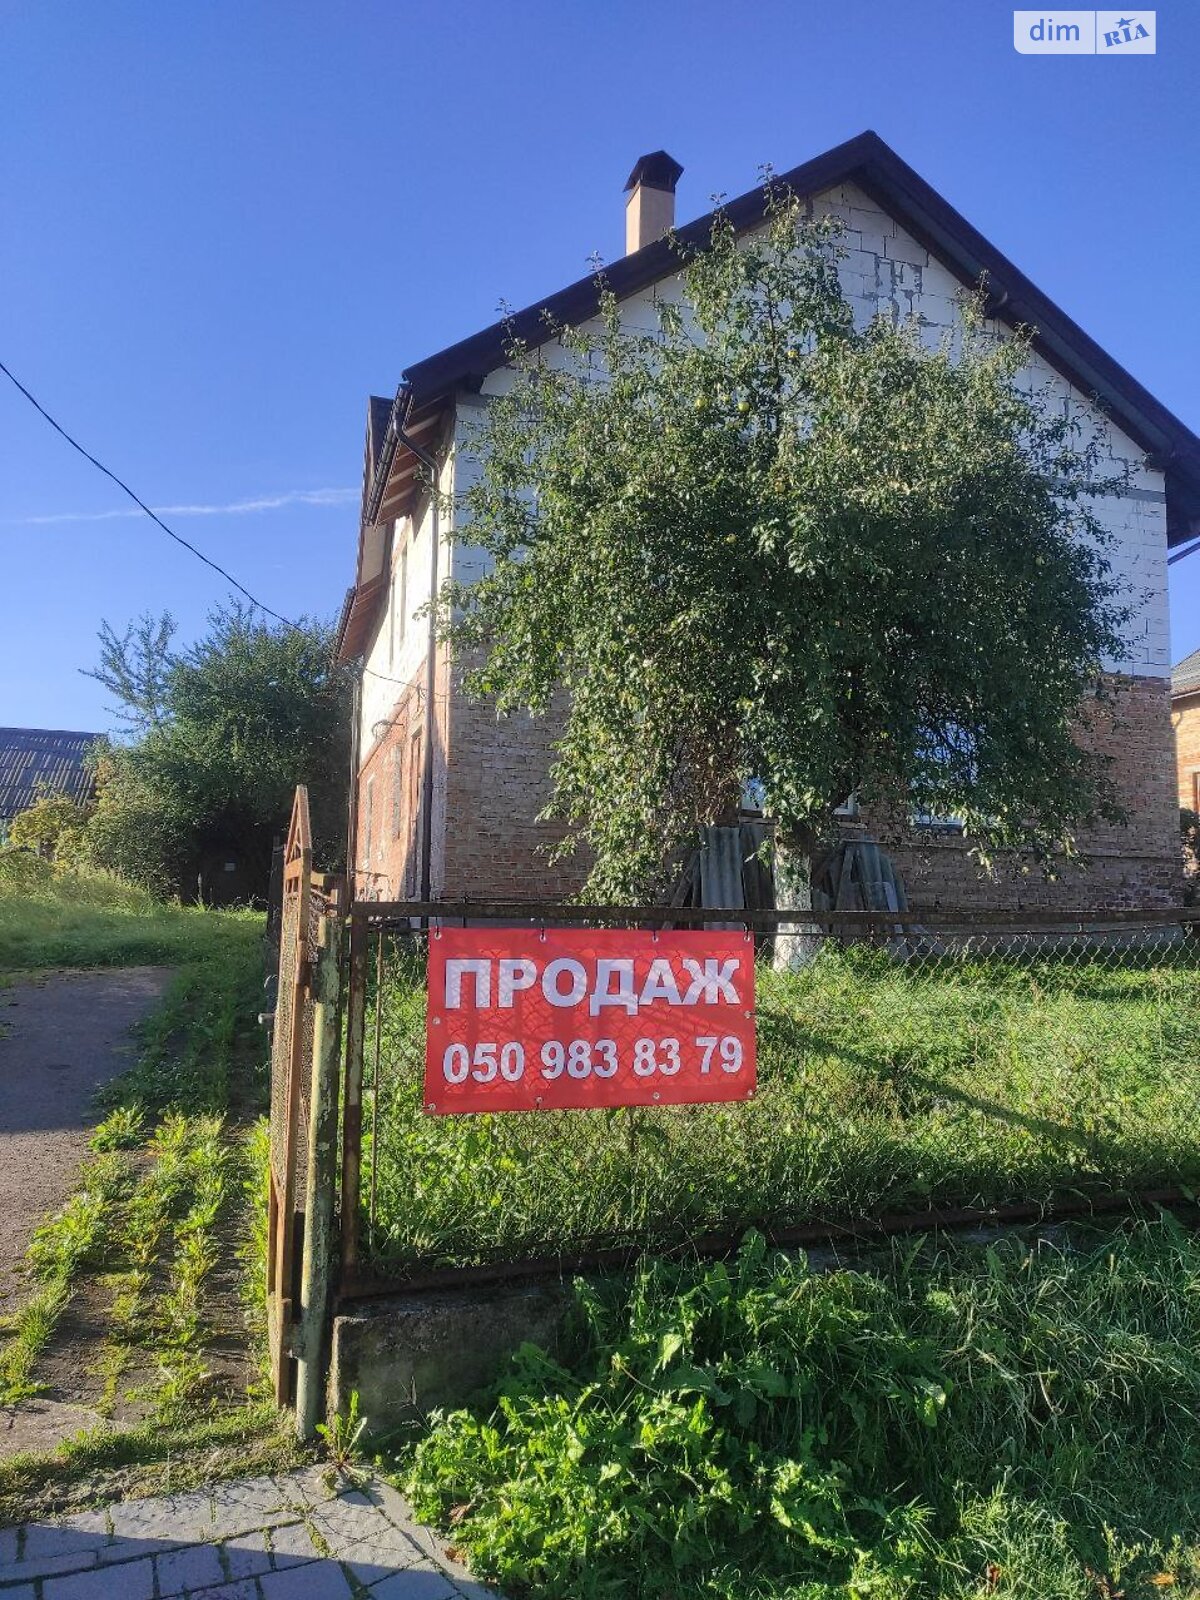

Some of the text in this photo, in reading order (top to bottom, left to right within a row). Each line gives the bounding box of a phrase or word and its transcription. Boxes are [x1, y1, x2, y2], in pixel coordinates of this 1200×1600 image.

[444, 957, 741, 1017] ПРОДАЖ
[442, 1034, 744, 1084] 050 983 83 79
